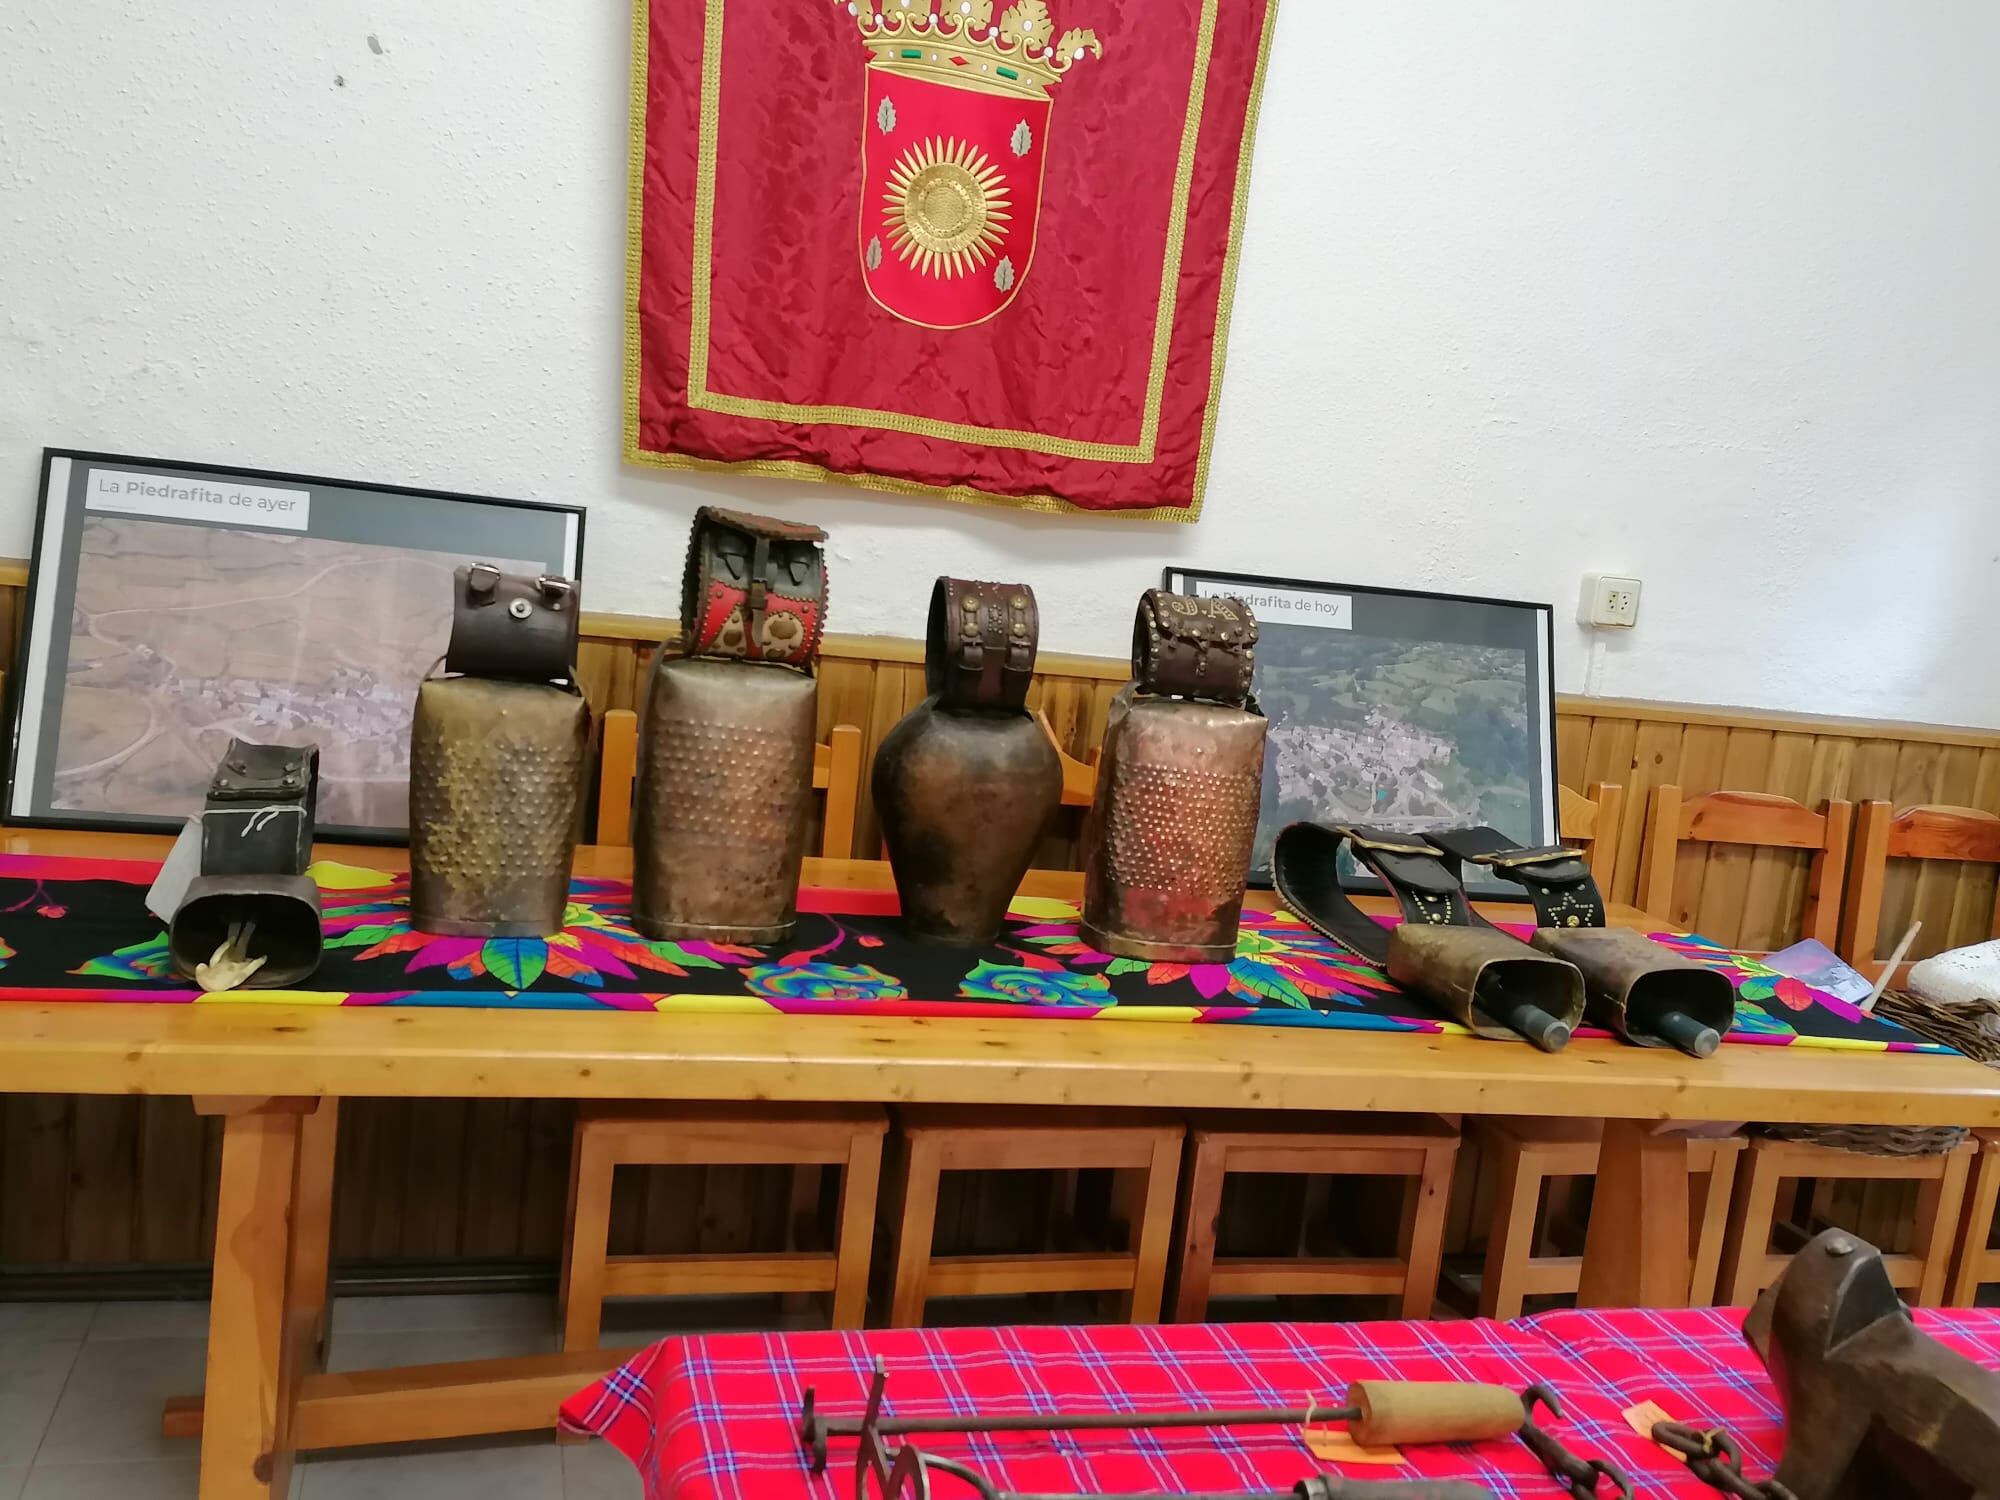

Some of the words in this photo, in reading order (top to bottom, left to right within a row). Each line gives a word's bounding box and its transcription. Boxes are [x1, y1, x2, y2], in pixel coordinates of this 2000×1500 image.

[99, 479, 119, 493] La
[127, 481, 223, 504] Piedrafita
[229, 492, 251, 507] de
[257, 499, 296, 512] ayer
[1295, 599, 1311, 611] de
[1315, 600, 1339, 616] hoy
